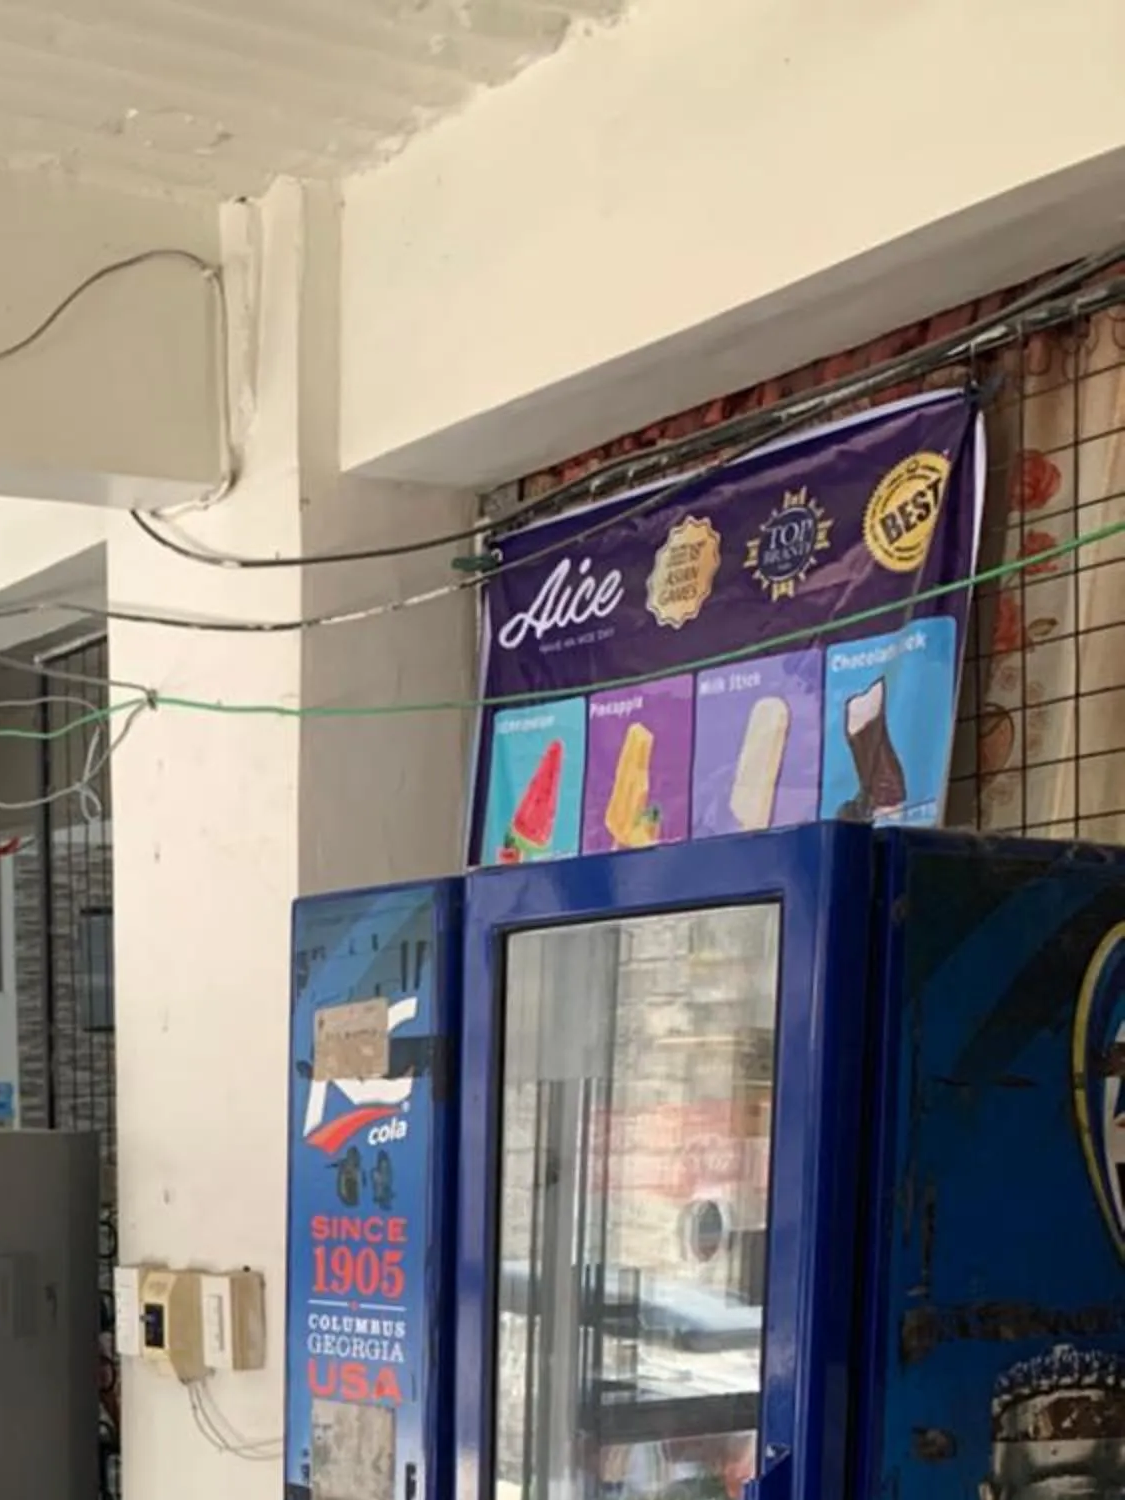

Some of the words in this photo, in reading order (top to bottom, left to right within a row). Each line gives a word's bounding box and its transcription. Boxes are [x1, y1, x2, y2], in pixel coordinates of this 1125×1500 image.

[879, 478, 942, 545] BEST
[766, 519, 813, 549] TOP
[499, 557, 624, 648] Aice
[367, 1117, 408, 1145] cola
[310, 1215, 408, 1244] SINCE
[313, 1246, 405, 1300] 1905
[307, 1313, 406, 1339] COLUMBUS
[306, 1332, 405, 1364] GEORGIA
[307, 1357, 403, 1408] USA
